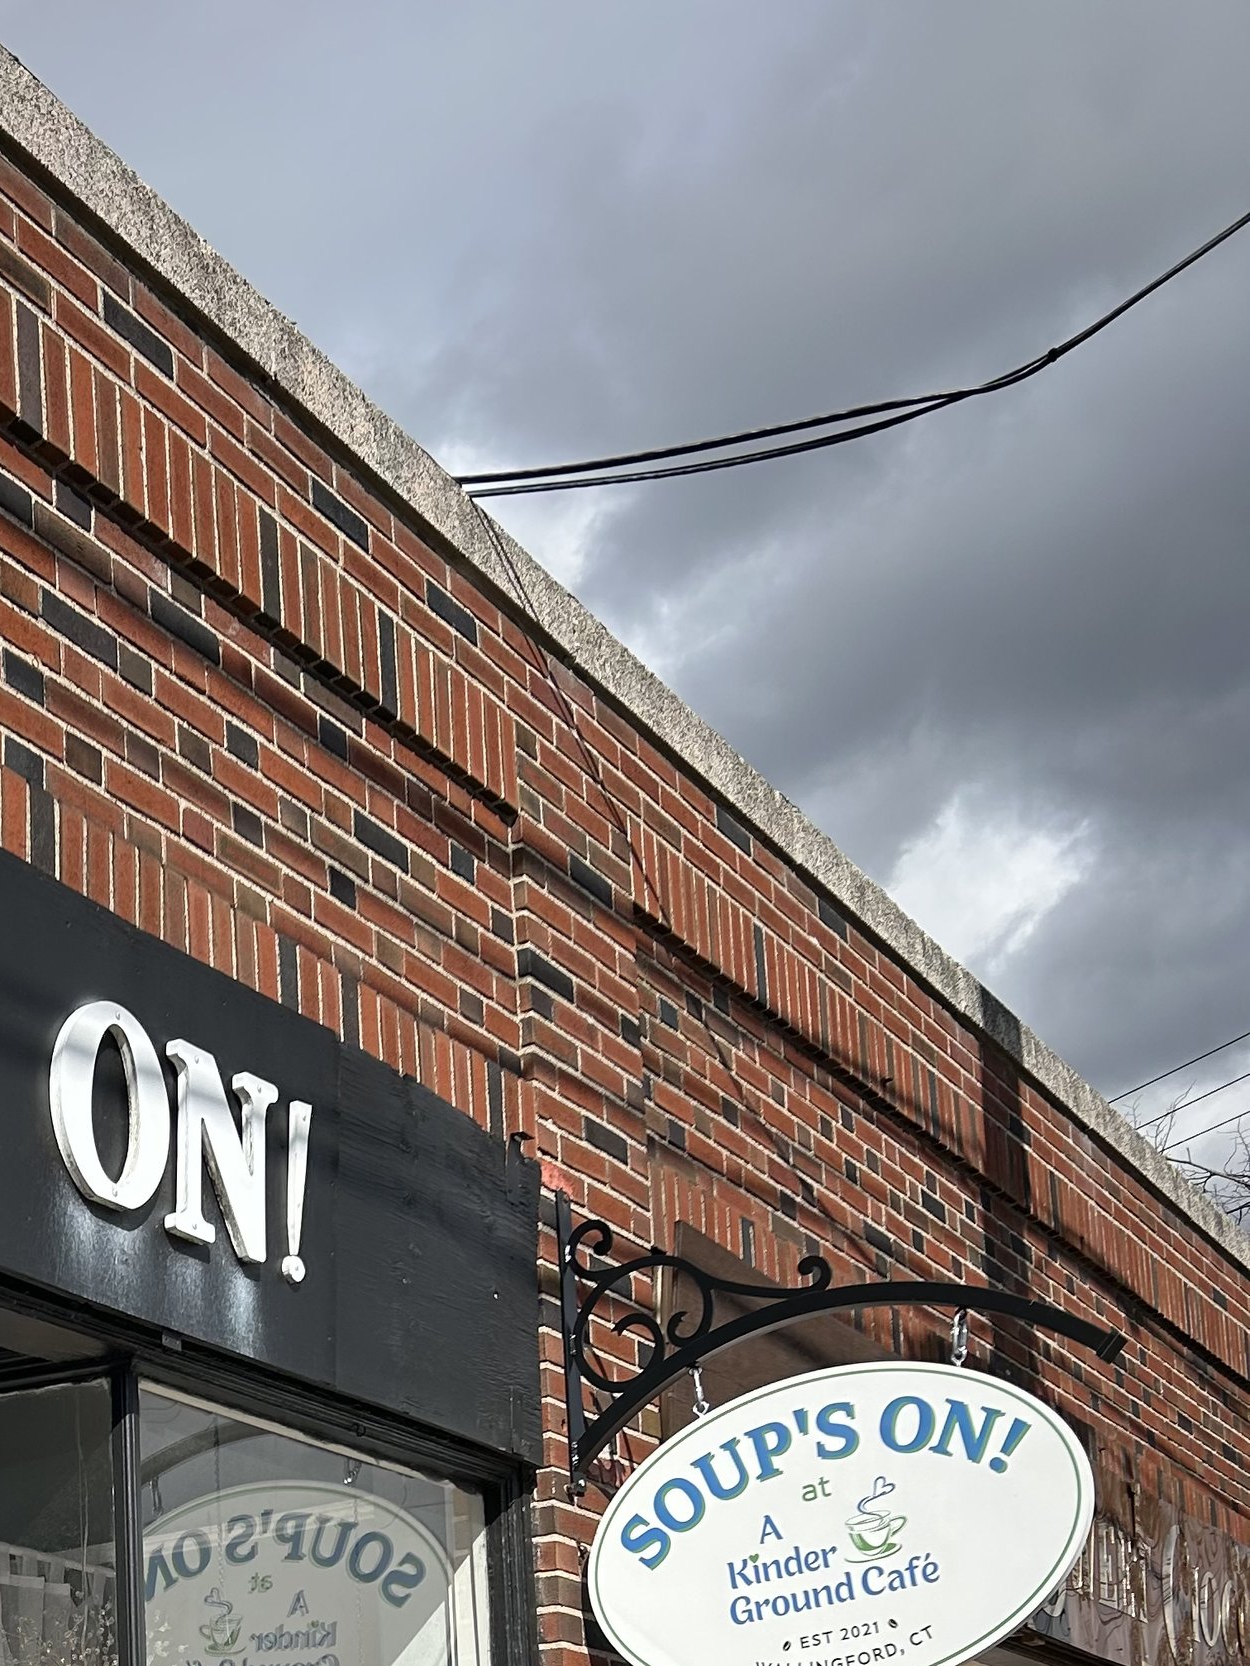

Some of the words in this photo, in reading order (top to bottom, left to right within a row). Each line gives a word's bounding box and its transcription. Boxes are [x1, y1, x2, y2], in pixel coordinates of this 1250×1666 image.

[49, 1000, 312, 1283] ON!
[620, 1401, 861, 1571] SOUP'S
[880, 1396, 1032, 1474] ON!
[802, 1477, 832, 1501] at
[759, 1515, 784, 1544] A
[727, 1546, 838, 1590] Kinder
[729, 1571, 856, 1625] Ground
[861, 1553, 941, 1596] Café
[800, 1630, 833, 1649] EST
[841, 1621, 880, 1641] 2021
[909, 1625, 934, 1646] CT
